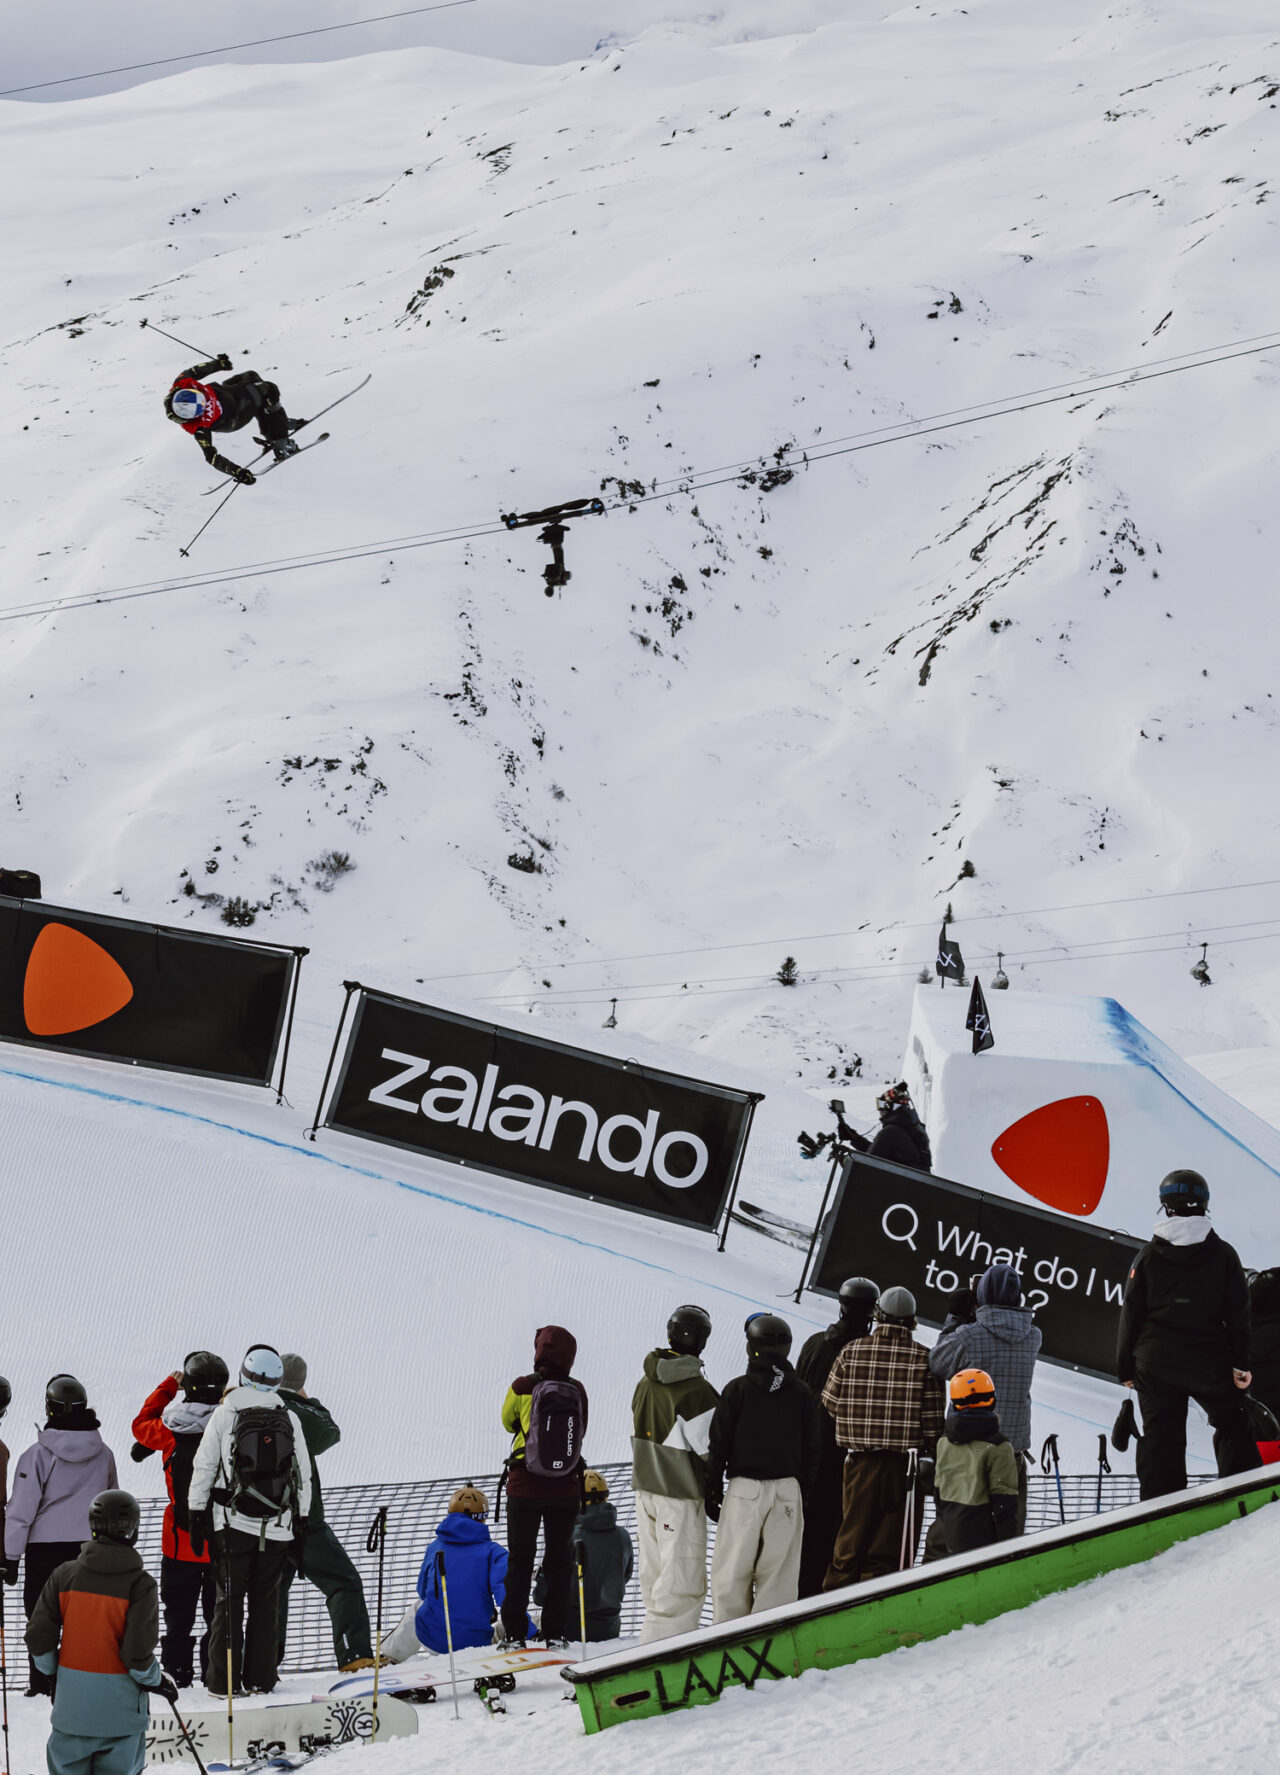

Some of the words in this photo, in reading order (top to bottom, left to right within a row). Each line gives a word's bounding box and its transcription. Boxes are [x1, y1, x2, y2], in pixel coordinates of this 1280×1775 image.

[368, 1047, 709, 1189] zalando
[925, 1259, 959, 1293] to
[937, 1220, 1028, 1276] What
[1033, 1256, 1078, 1290] do
[1085, 1267, 1097, 1296] I
[1103, 1279, 1126, 1306] w
[654, 1638, 786, 1712] LAAX
